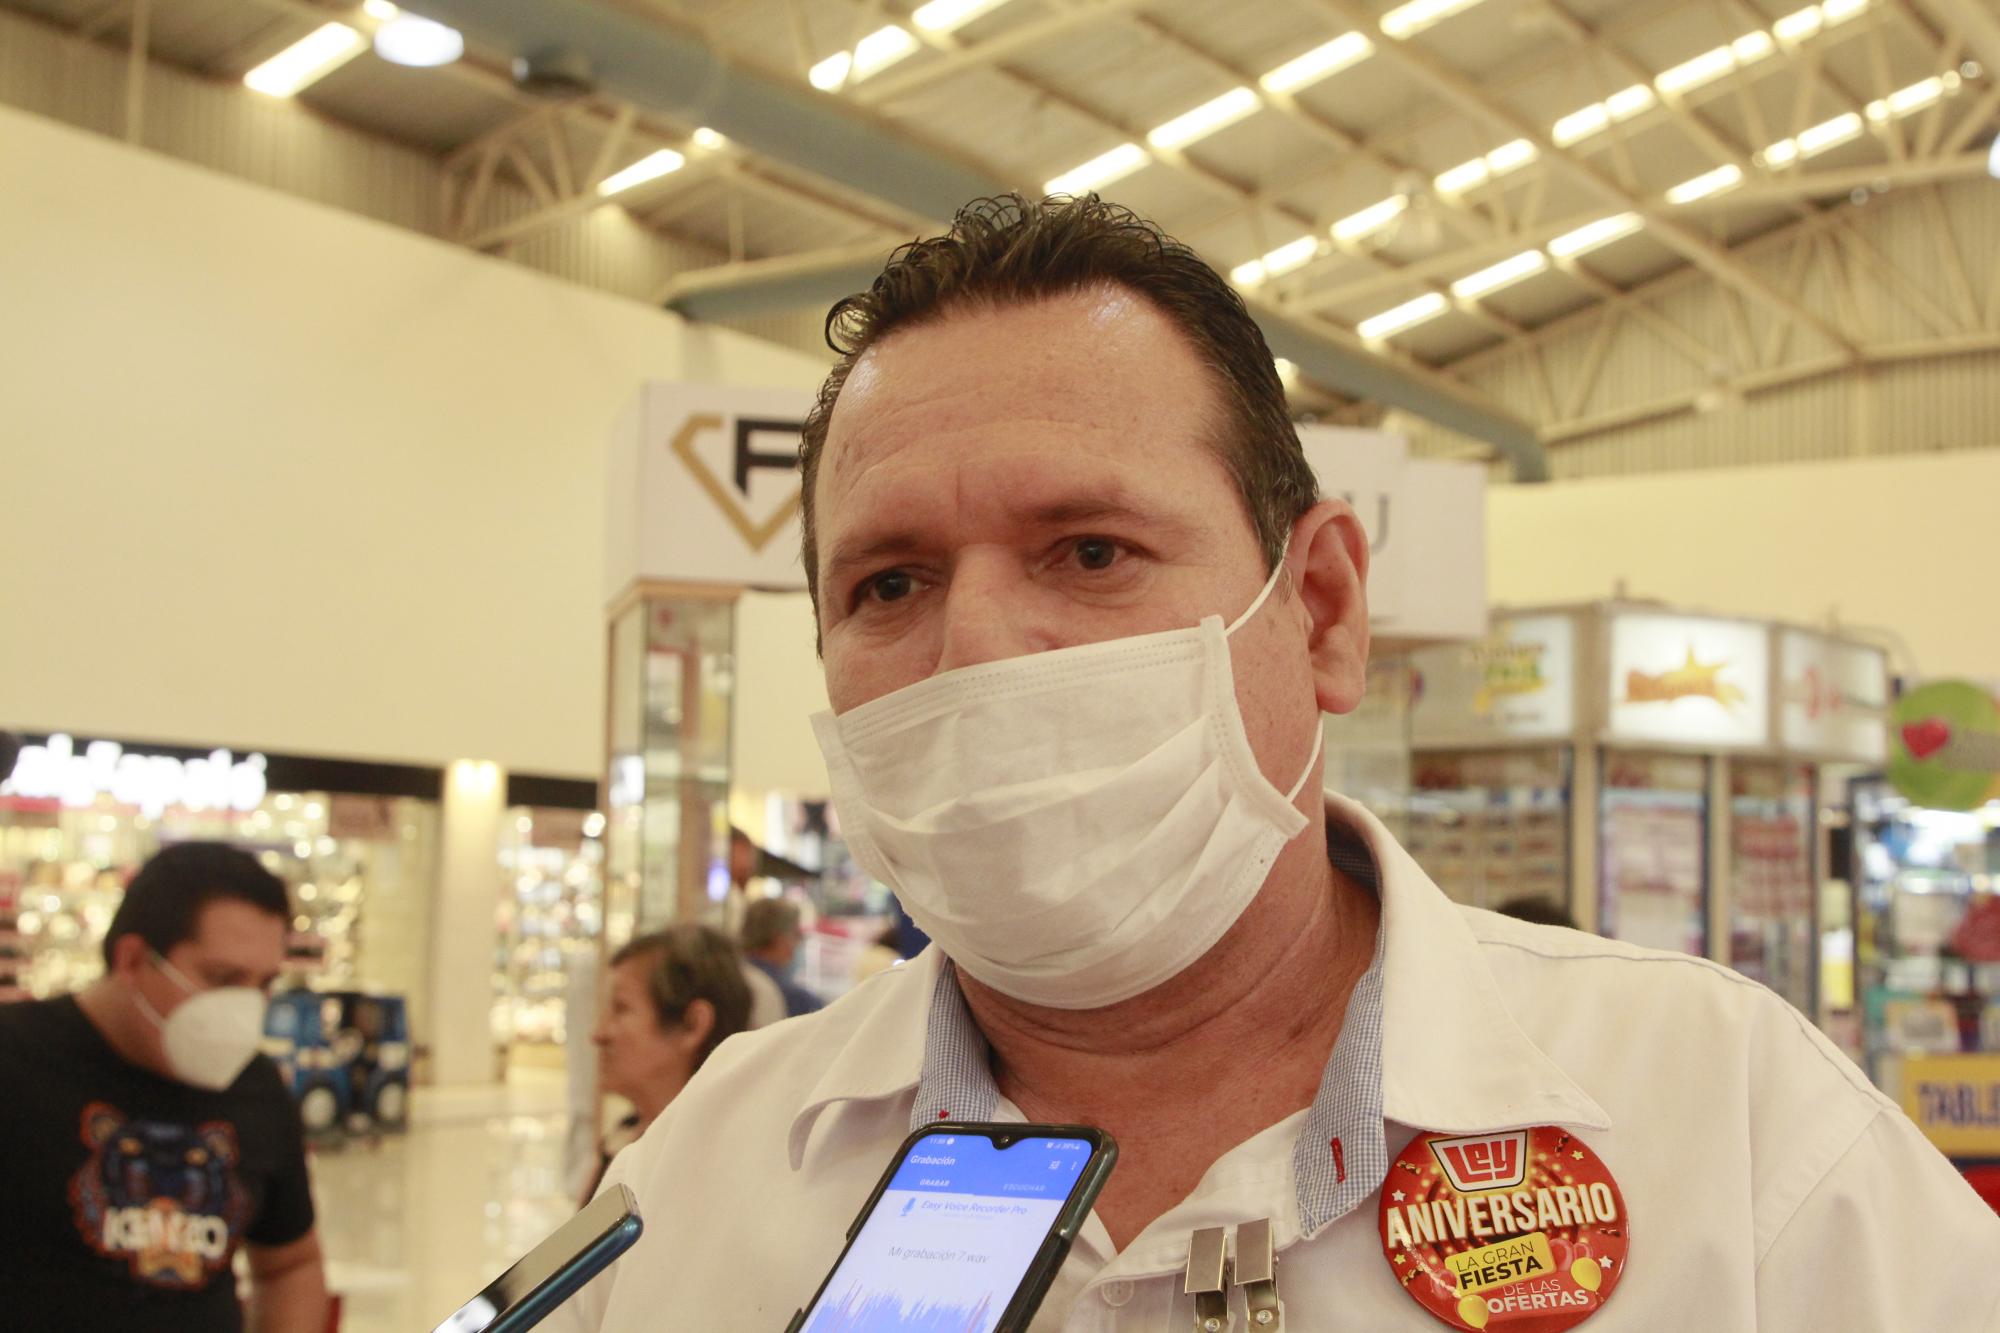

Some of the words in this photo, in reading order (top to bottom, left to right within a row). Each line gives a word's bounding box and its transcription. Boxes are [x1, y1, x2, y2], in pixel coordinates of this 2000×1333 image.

[910, 1154, 956, 1167] Grabación
[921, 1200, 942, 1211] Easy
[969, 1203, 1010, 1213] Recorder
[1011, 1205, 1028, 1215] Pro
[1387, 1182, 1617, 1249] ANIVERSARIO
[103, 1206, 228, 1259] KENZO
[1455, 1254, 1480, 1273] LA
[1482, 1240, 1534, 1264] GRAN
[1458, 1254, 1543, 1290] FIESTA
[1487, 1289, 1589, 1314] OFERTAS
[1502, 1283, 1528, 1296] DE
[1530, 1279, 1561, 1293] LAS
